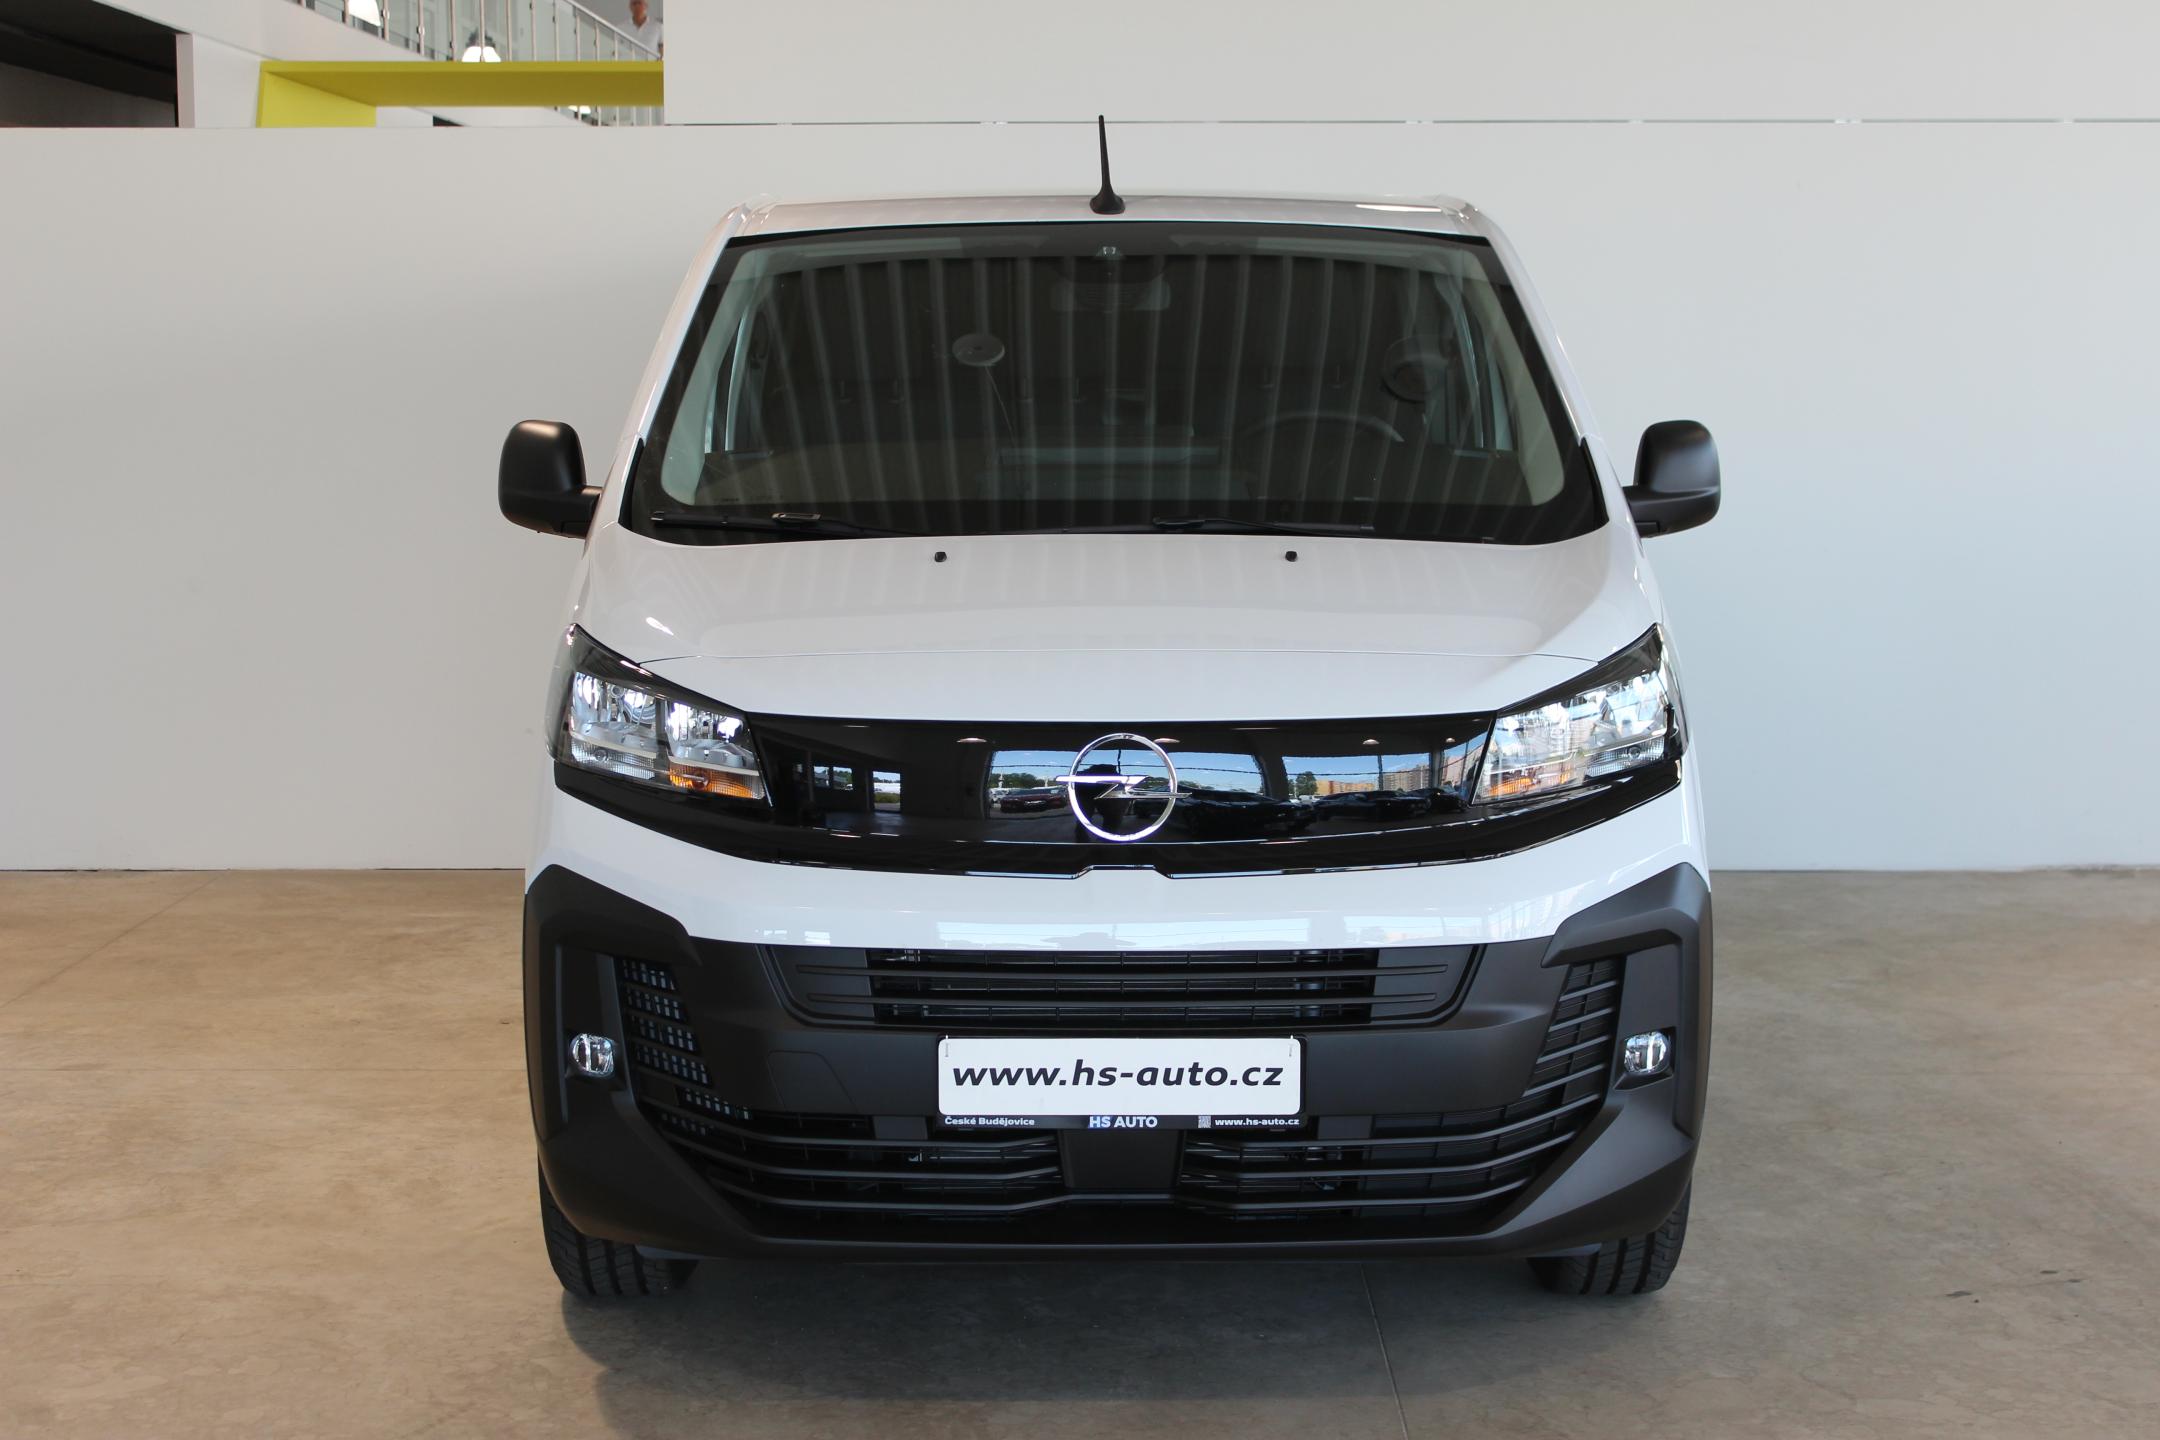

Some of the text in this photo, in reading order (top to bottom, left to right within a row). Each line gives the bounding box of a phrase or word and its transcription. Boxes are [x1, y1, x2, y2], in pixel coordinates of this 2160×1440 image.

[952, 1059, 1284, 1086] www.hs-auto.cz
[944, 1116, 1035, 1127] České Budějovice
[1089, 1116, 1158, 1128] HS AUTO
[1214, 1117, 1300, 1126] www.hs-auto.cz
